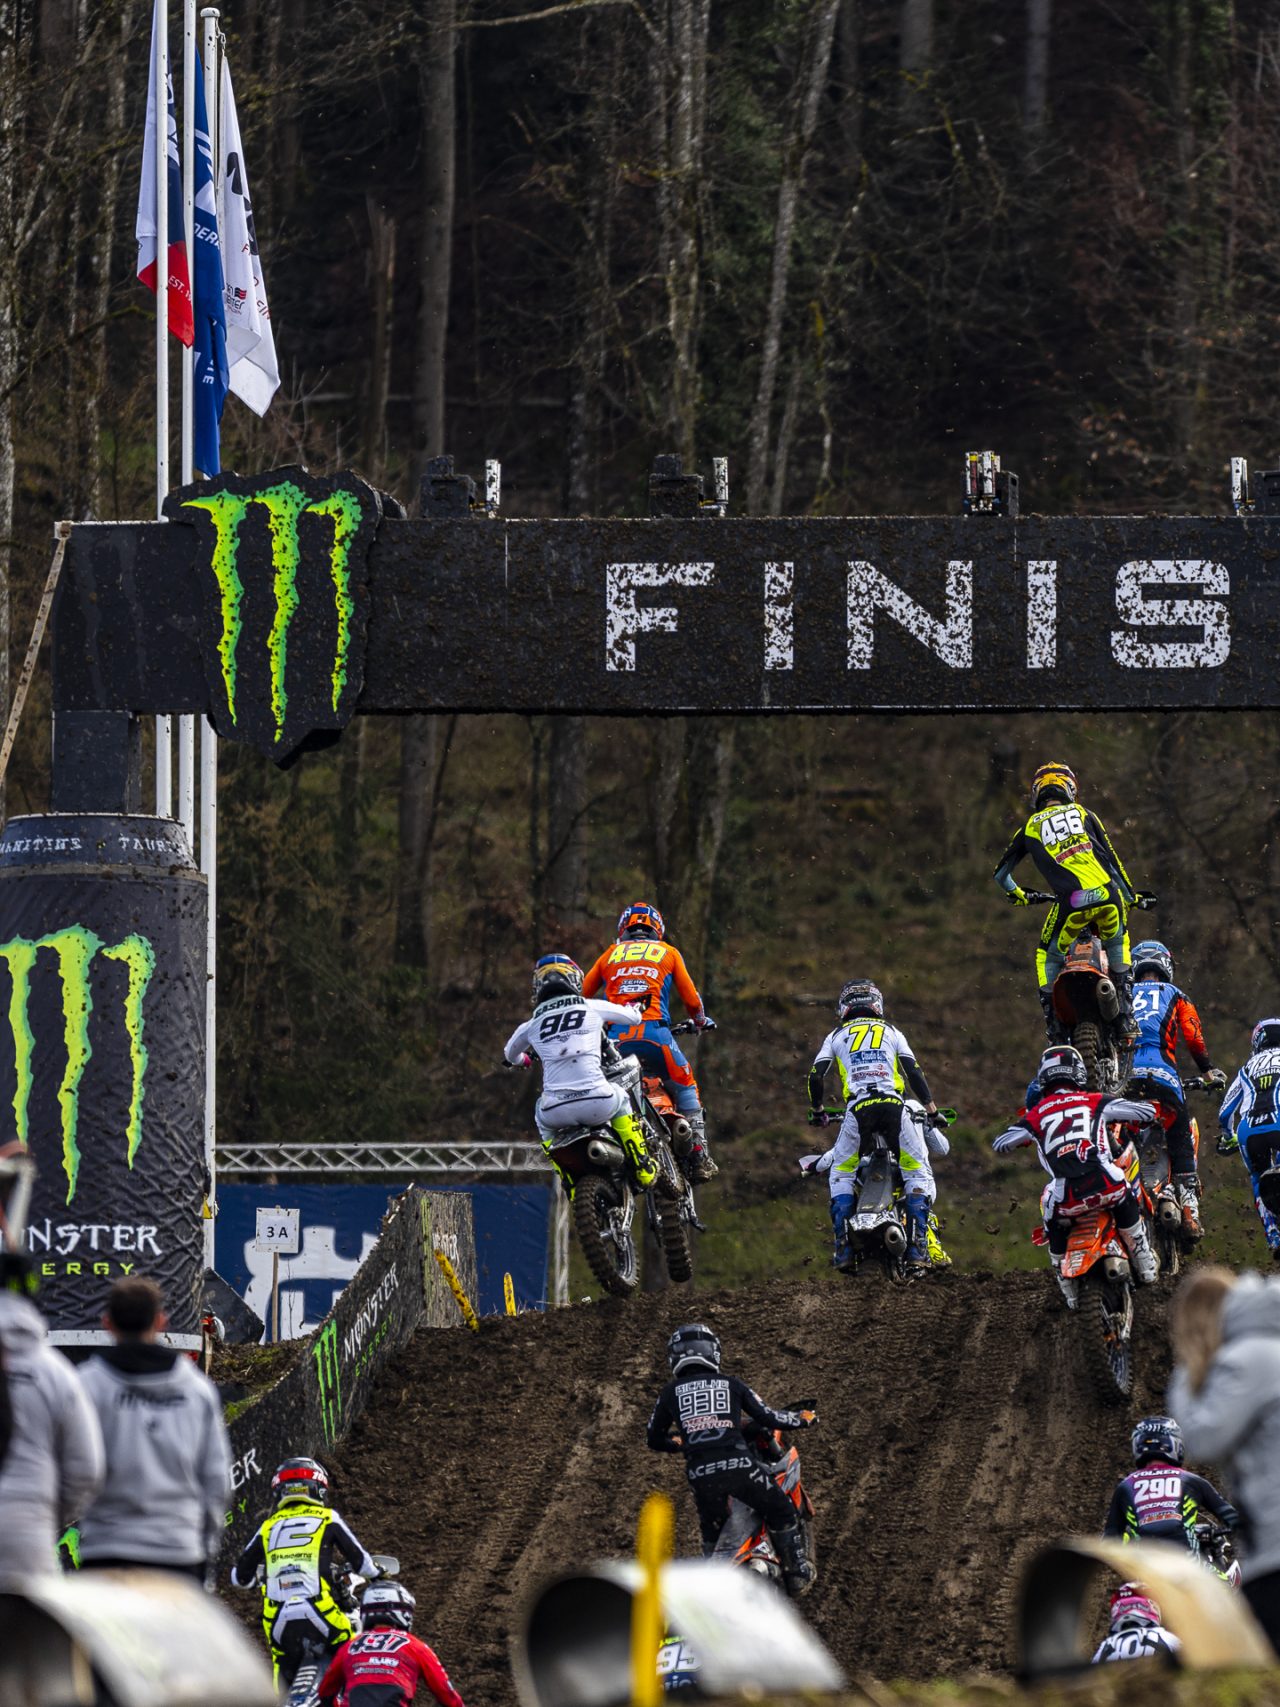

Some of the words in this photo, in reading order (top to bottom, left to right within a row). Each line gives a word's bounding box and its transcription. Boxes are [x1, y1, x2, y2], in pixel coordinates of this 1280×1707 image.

[1041, 809, 1085, 846] 456
[607, 942, 668, 965] 420
[540, 1009, 587, 1040] 98
[849, 1023, 885, 1053] 71
[1040, 1105, 1092, 1154] 23
[266, 1227, 274, 1238] 3
[277, 1227, 288, 1238] A
[344, 1261, 399, 1362] MONSTER
[679, 1389, 731, 1422] 938
[688, 1457, 753, 1480] ACERBIS
[1132, 1468, 1180, 1479] VOLKER
[1133, 1477, 1182, 1505] 290
[267, 1516, 324, 1554] 12
